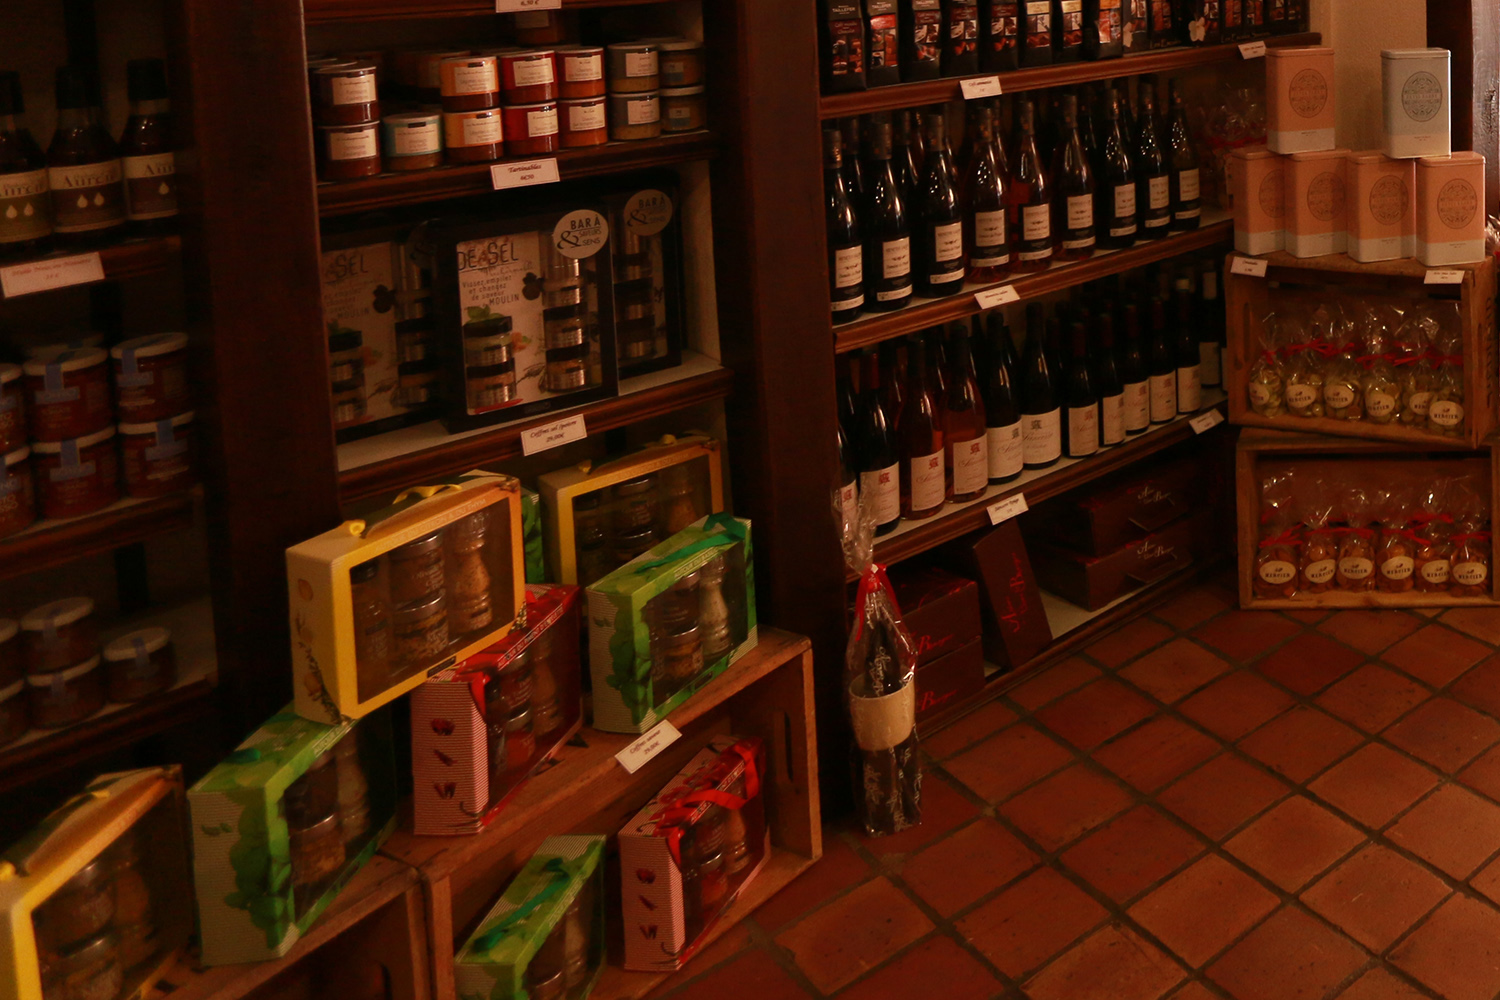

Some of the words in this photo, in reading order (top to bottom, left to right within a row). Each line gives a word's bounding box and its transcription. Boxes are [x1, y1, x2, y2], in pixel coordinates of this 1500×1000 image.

[571, 217, 592, 230] BAR
[583, 237, 600, 247] SENS
[487, 241, 519, 265] SEL
[335, 253, 369, 278] SEL
[489, 294, 520, 306] MOULIN
[1288, 395, 1312, 403] MERCIER
[1326, 395, 1348, 403] MERCIER
[1368, 404, 1390, 412] MERCIER
[1433, 412, 1459, 420] MERCIER
[1311, 568, 1334, 579] MERCIER
[1386, 567, 1411, 575] MERCIER
[1458, 572, 1483, 580] MERCIER
